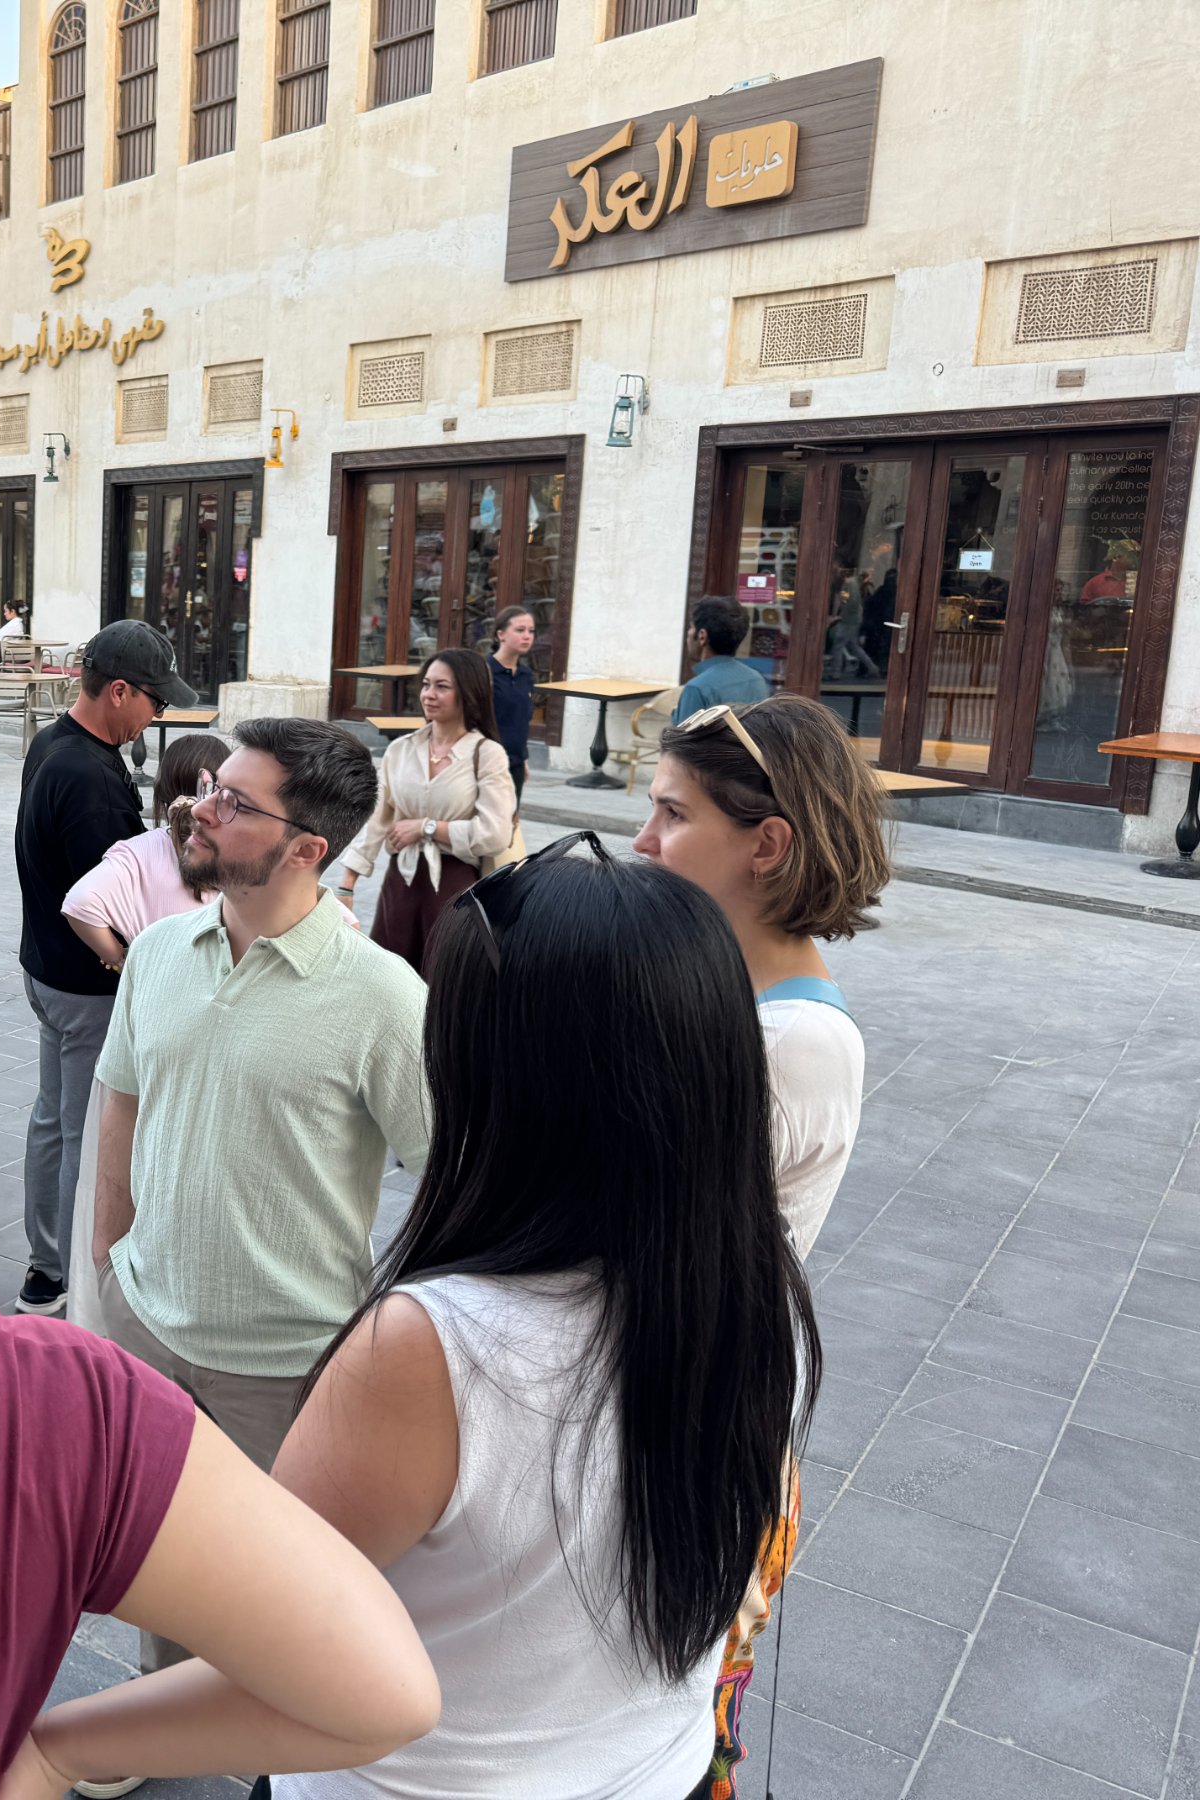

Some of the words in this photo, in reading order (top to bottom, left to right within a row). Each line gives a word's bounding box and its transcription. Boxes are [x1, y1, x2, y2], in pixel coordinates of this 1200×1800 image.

[715, 136, 784, 193] حلويات
[111, 307, 166, 366] مقهى
[1105, 453, 1124, 462] you
[1126, 451, 1137, 460] to
[1138, 450, 1154, 460] ind
[1069, 466, 1107, 476] culinary
[1109, 464, 1152, 474] excellen
[1088, 481, 1114, 491] early
[1115, 481, 1135, 490] 20th
[1137, 481, 1151, 489] ce
[1090, 494, 1124, 505] quickly
